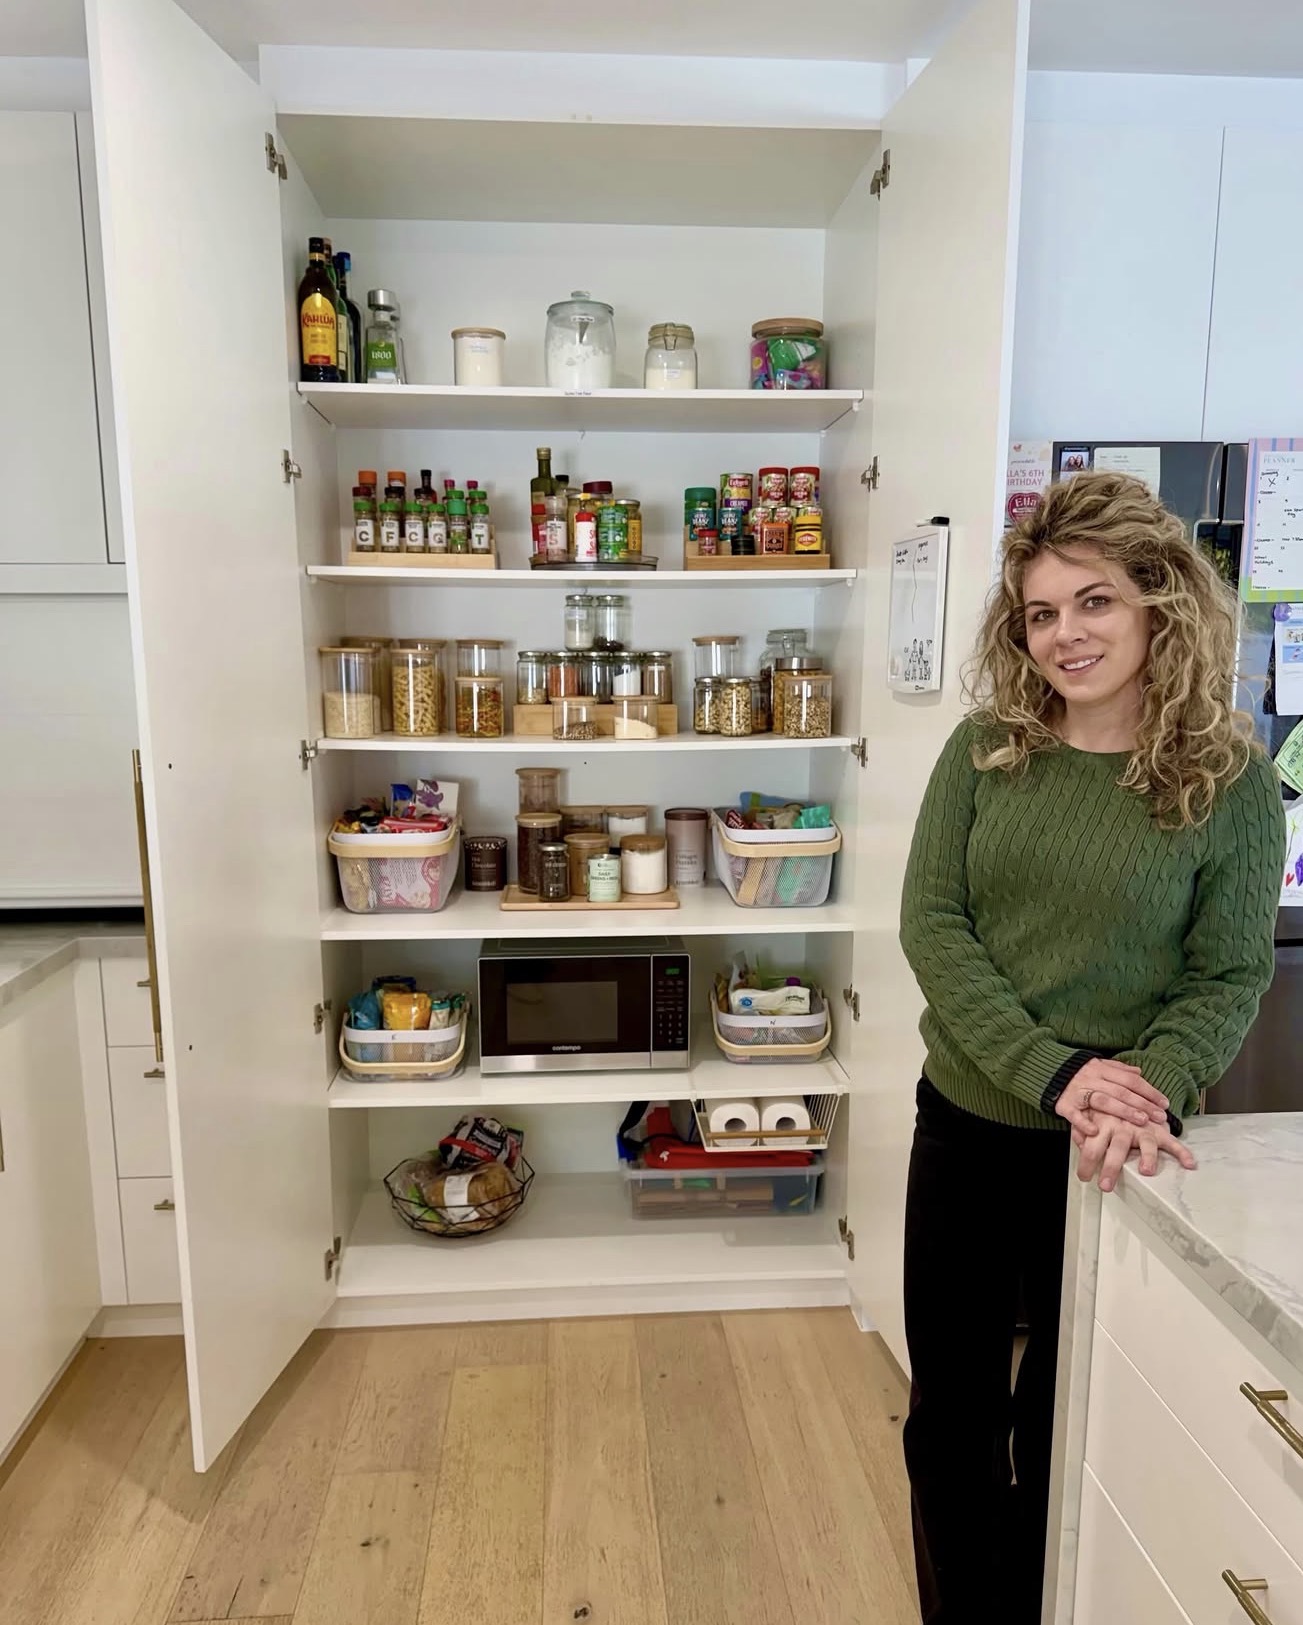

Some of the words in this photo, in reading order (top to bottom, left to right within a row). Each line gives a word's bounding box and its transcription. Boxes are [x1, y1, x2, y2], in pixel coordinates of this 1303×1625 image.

[371, 350, 392, 359] 1800
[1028, 469, 1045, 478] 6TH
[1007, 478, 1042, 487] IRTHDAY
[1014, 497, 1037, 507] Ella
[358, 530, 369, 542] C
[385, 531, 395, 543] F
[408, 531, 418, 542] C
[474, 533, 485, 545] T
